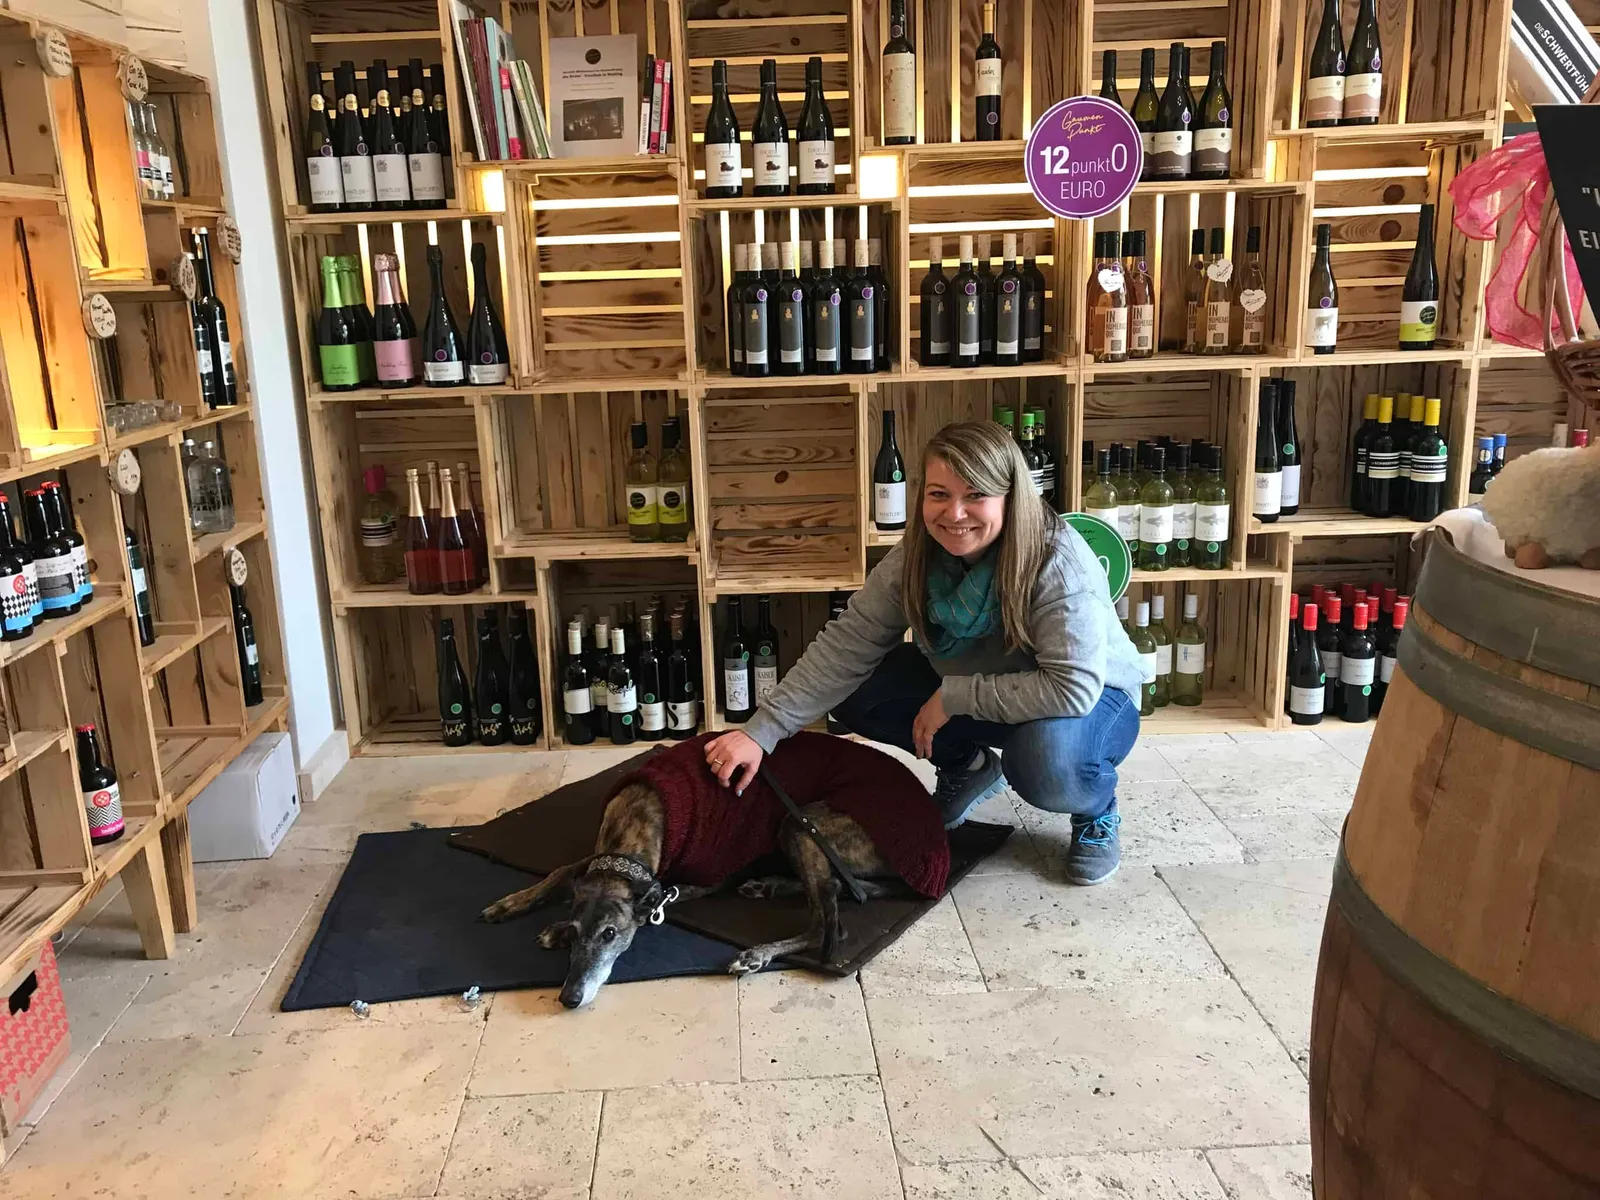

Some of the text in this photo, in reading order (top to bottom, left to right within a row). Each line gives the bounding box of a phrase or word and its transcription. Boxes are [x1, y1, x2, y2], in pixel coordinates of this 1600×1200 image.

[1061, 110, 1104, 130] Gaumen
[1067, 123, 1106, 141] Punkt
[1060, 180, 1106, 199] EURO
[1106, 311, 1116, 323] IN
[1133, 307, 1143, 318] IN
[1209, 303, 1218, 316] IN
